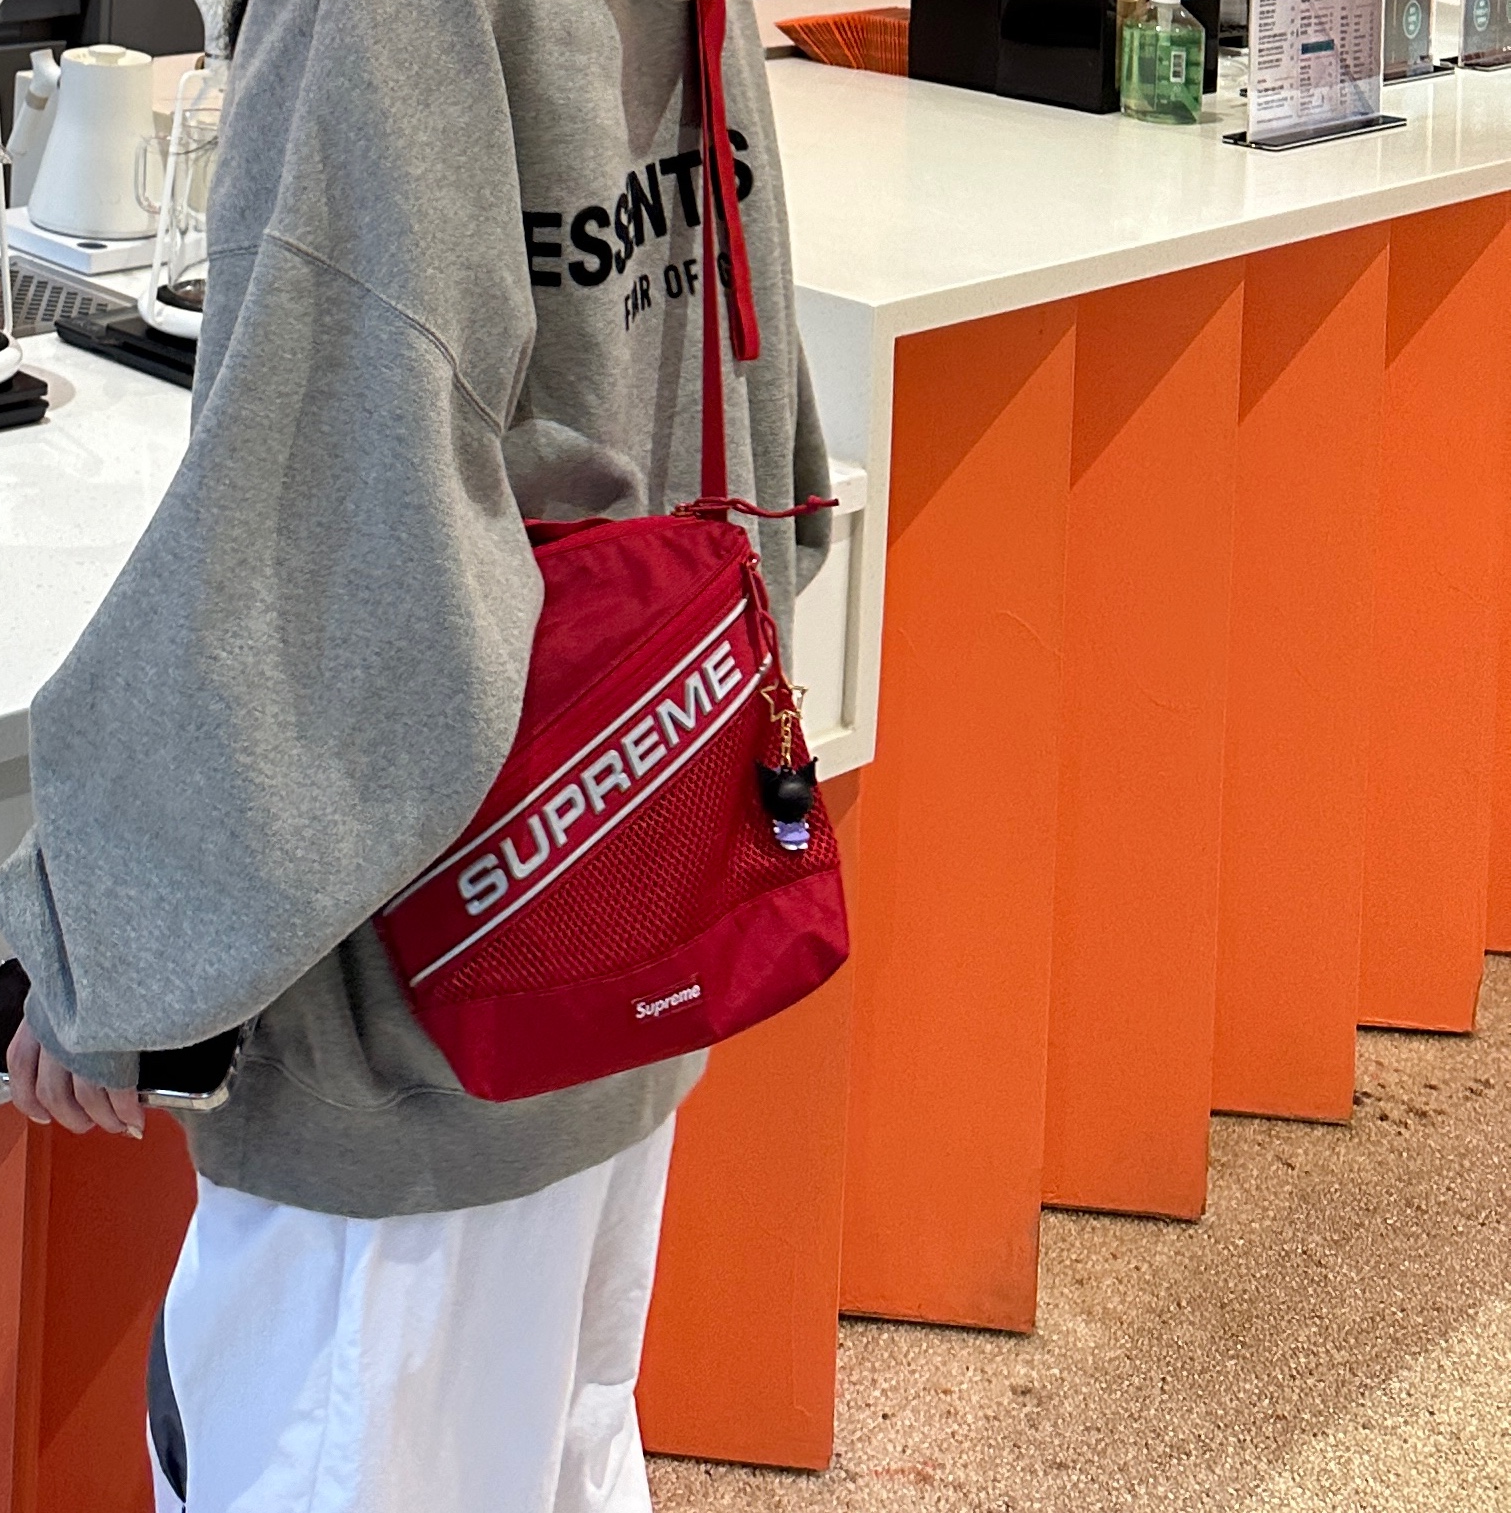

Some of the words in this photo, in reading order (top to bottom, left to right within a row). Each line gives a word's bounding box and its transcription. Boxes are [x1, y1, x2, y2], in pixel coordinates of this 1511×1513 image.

[663, 258, 699, 299] OF
[457, 640, 742, 916] SUPREME
[635, 984, 701, 1019] Supreme
